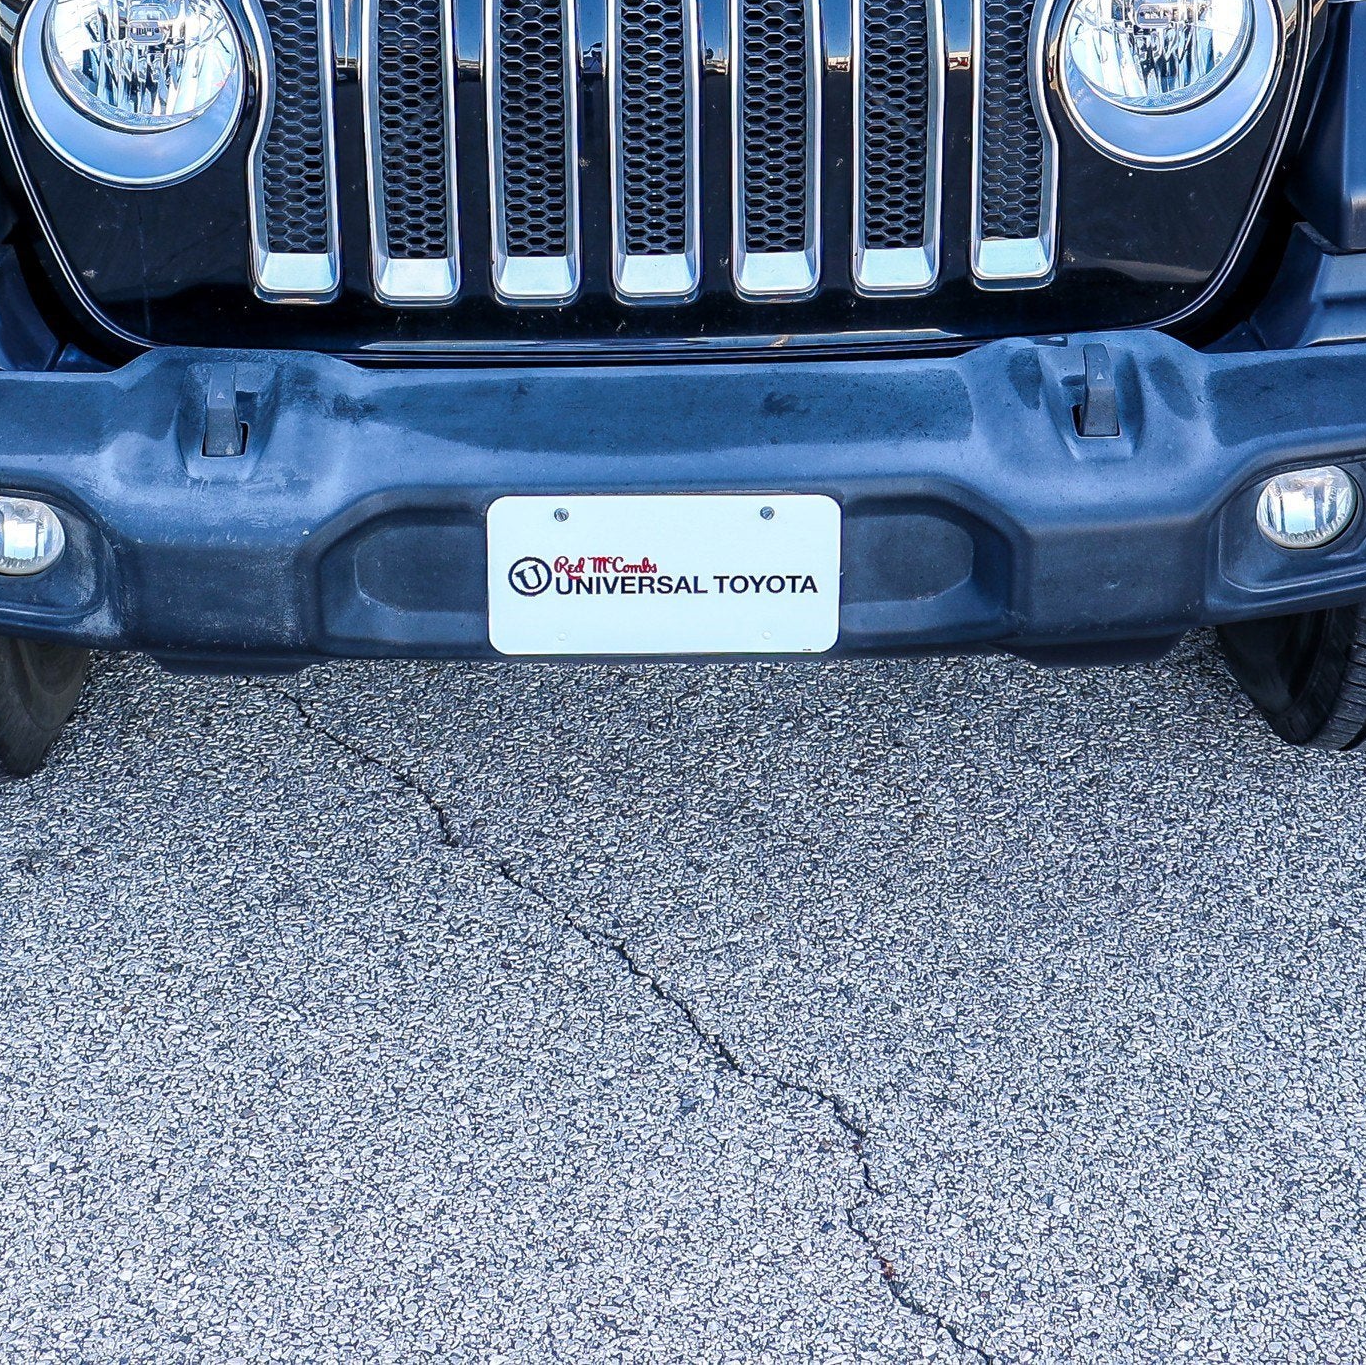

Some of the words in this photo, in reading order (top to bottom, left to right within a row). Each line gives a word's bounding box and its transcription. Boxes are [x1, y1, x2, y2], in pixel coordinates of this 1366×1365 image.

[554, 556, 585, 580] Red
[588, 556, 658, 574] McCombs
[555, 575, 708, 595] UNIVERSAL
[713, 575, 819, 594] TOYOTA
